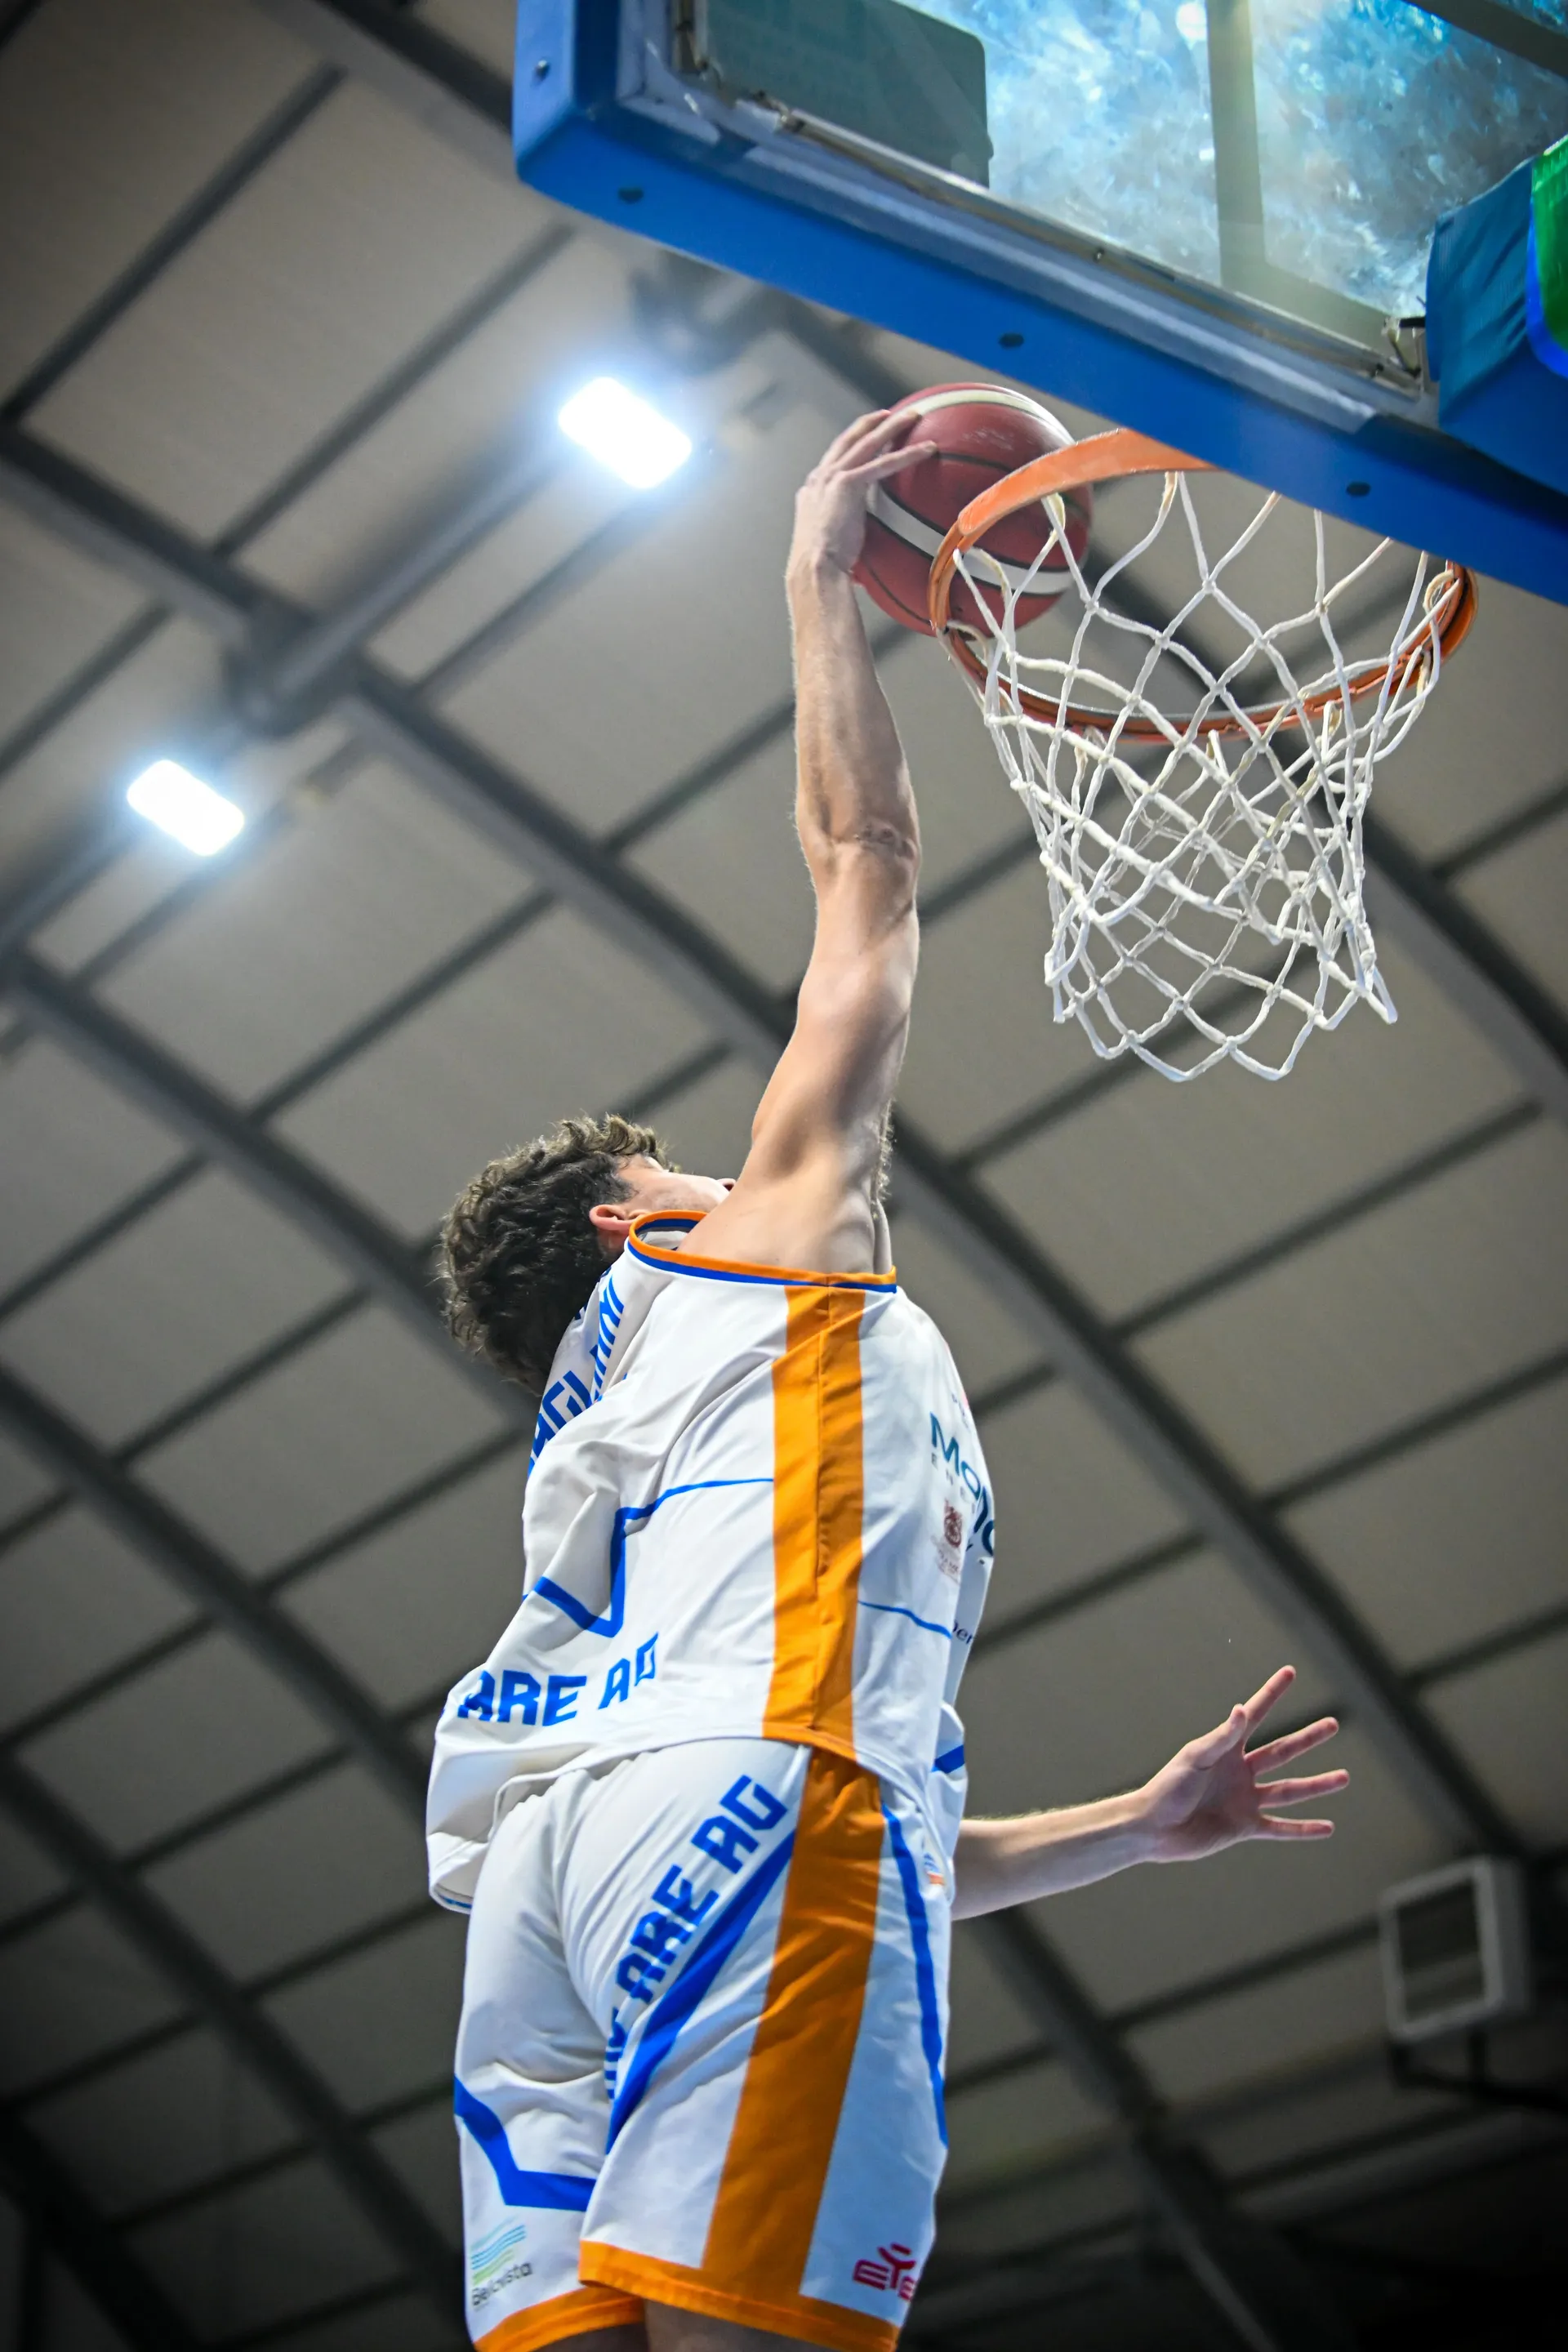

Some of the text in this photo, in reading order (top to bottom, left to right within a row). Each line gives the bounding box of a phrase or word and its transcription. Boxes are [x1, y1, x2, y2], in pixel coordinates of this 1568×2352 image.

[457, 1669, 587, 1726] ARE
[616, 1775, 788, 2004] ARE AG
